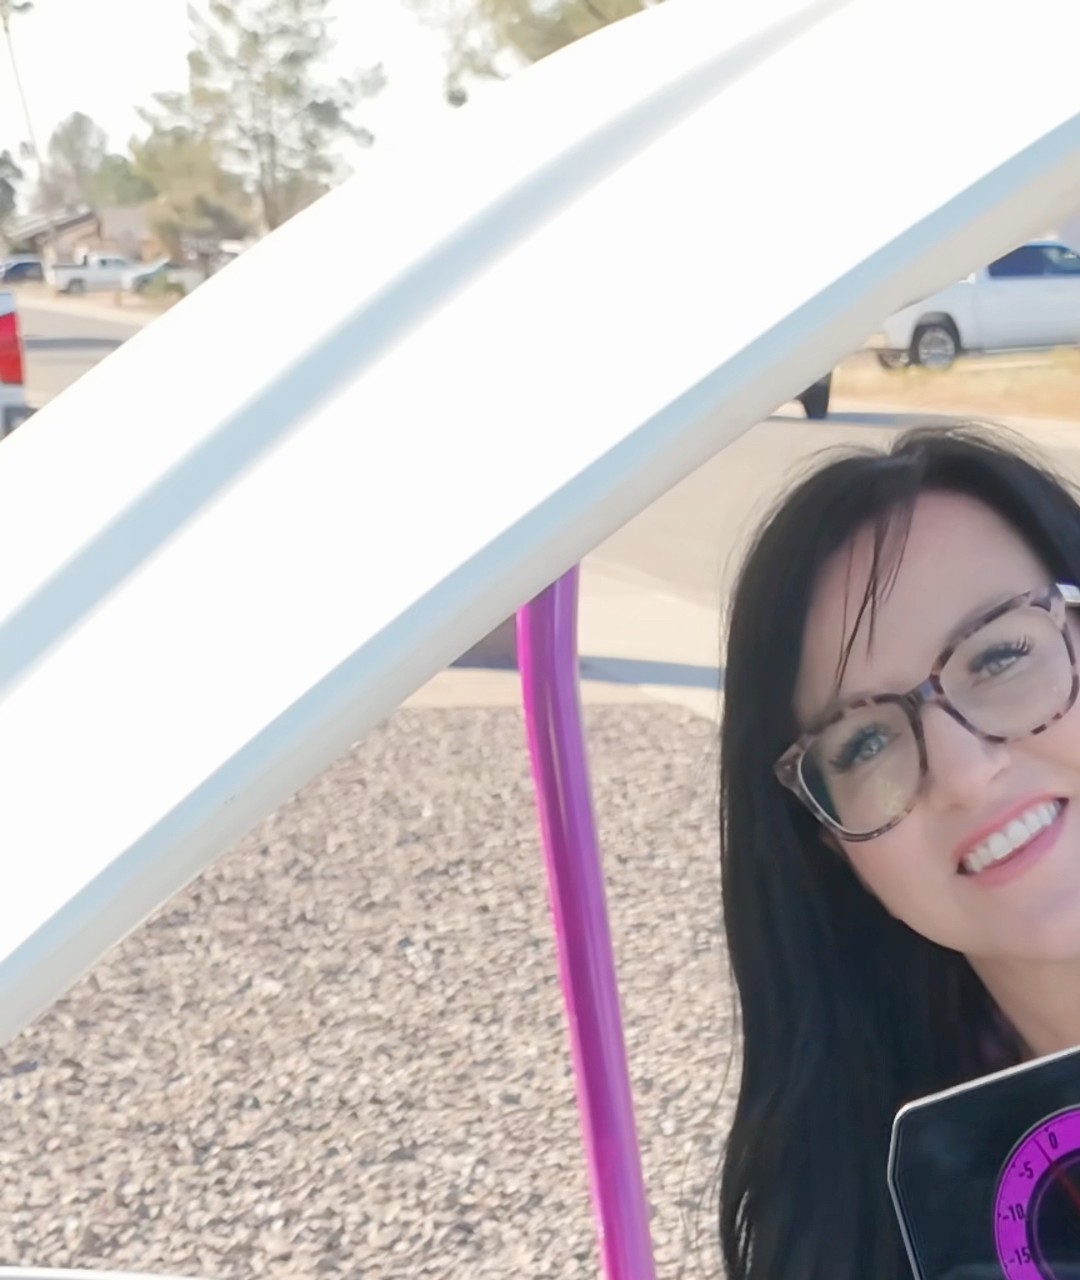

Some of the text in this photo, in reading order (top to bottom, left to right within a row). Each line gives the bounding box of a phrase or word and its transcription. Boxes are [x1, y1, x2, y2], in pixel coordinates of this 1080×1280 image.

[1048, 1131, 1059, 1150] 0
[1018, 1164, 1034, 1180] -5
[1002, 1203, 1025, 1222] -10
[1008, 1248, 1031, 1266] -15
